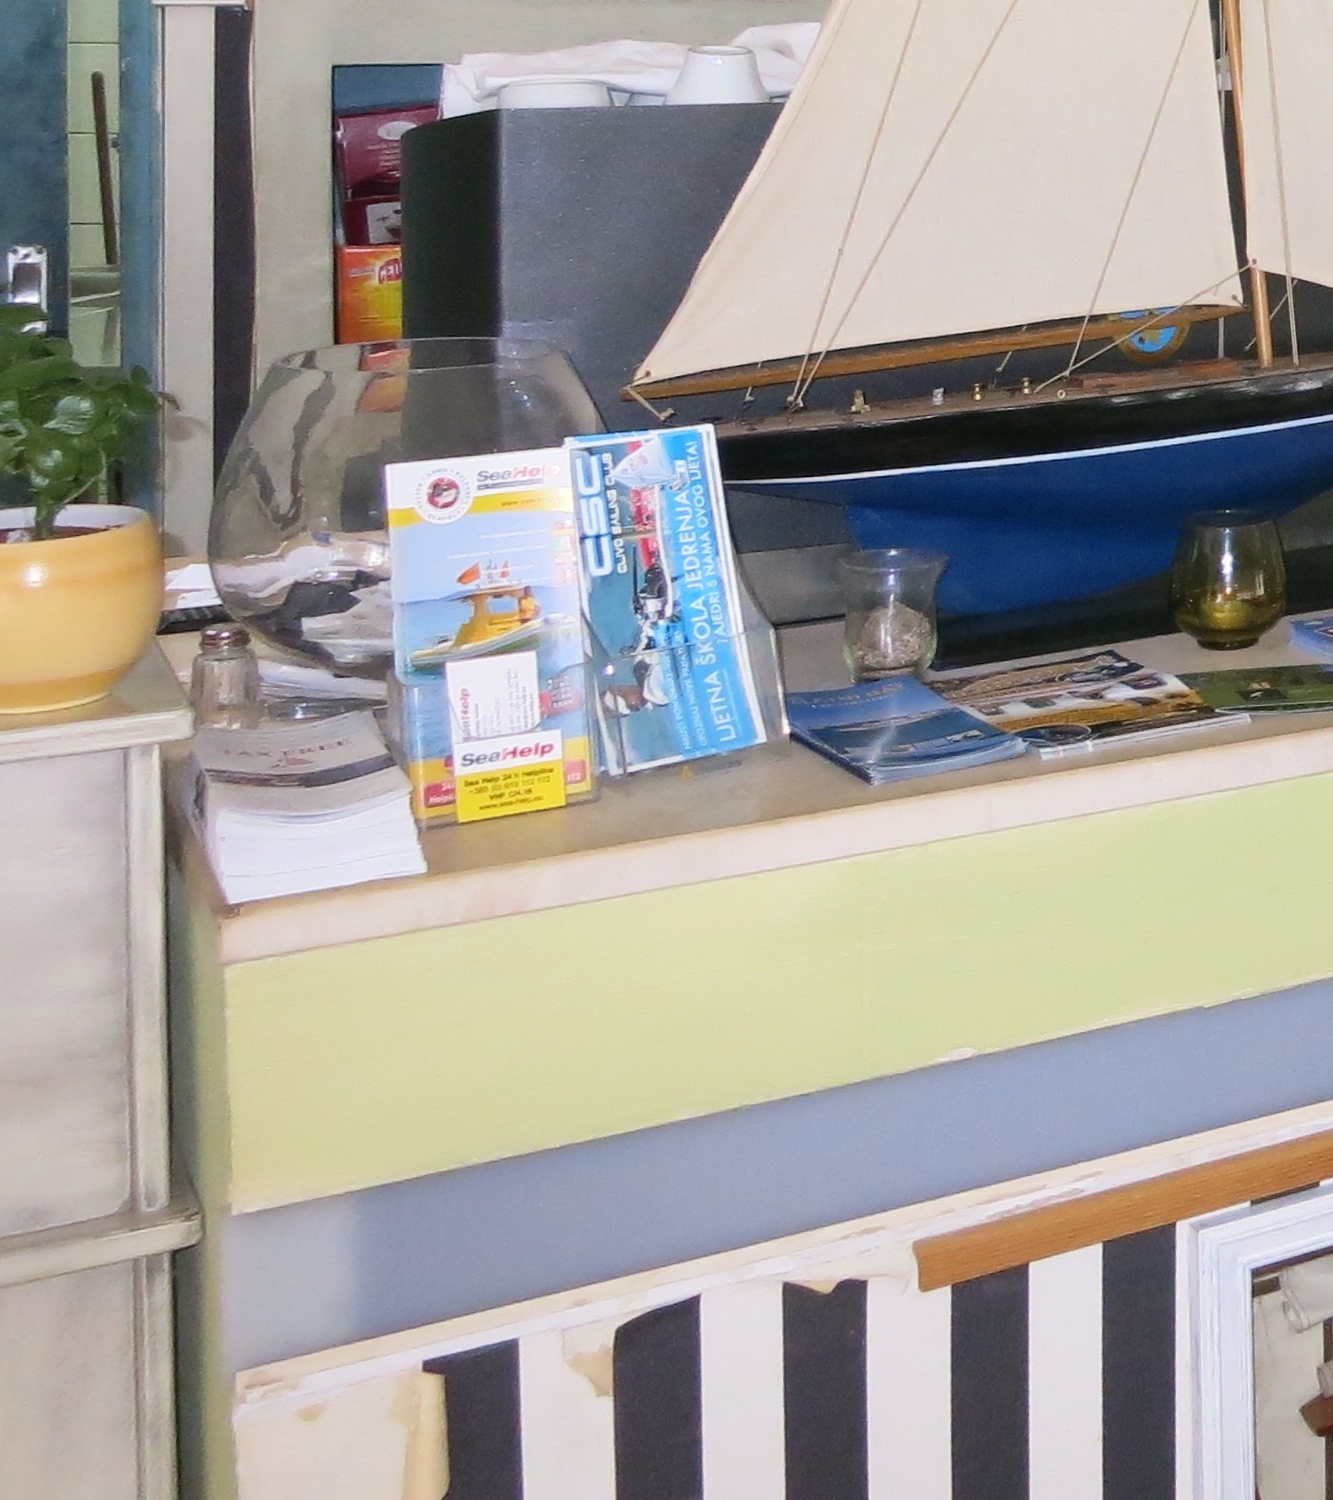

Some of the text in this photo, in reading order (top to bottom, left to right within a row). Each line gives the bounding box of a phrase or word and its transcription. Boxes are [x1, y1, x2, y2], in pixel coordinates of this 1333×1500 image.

[477, 464, 558, 483] SeaHe
[576, 454, 613, 577] CSC
[691, 484, 711, 528] OVOG
[678, 490, 710, 590] JEDRENJA
[699, 531, 717, 576] NAMA
[706, 579, 719, 588] S
[687, 595, 717, 666] ŠKOLA
[705, 670, 737, 743] LJETNA
[461, 742, 555, 768] SeaHelp
